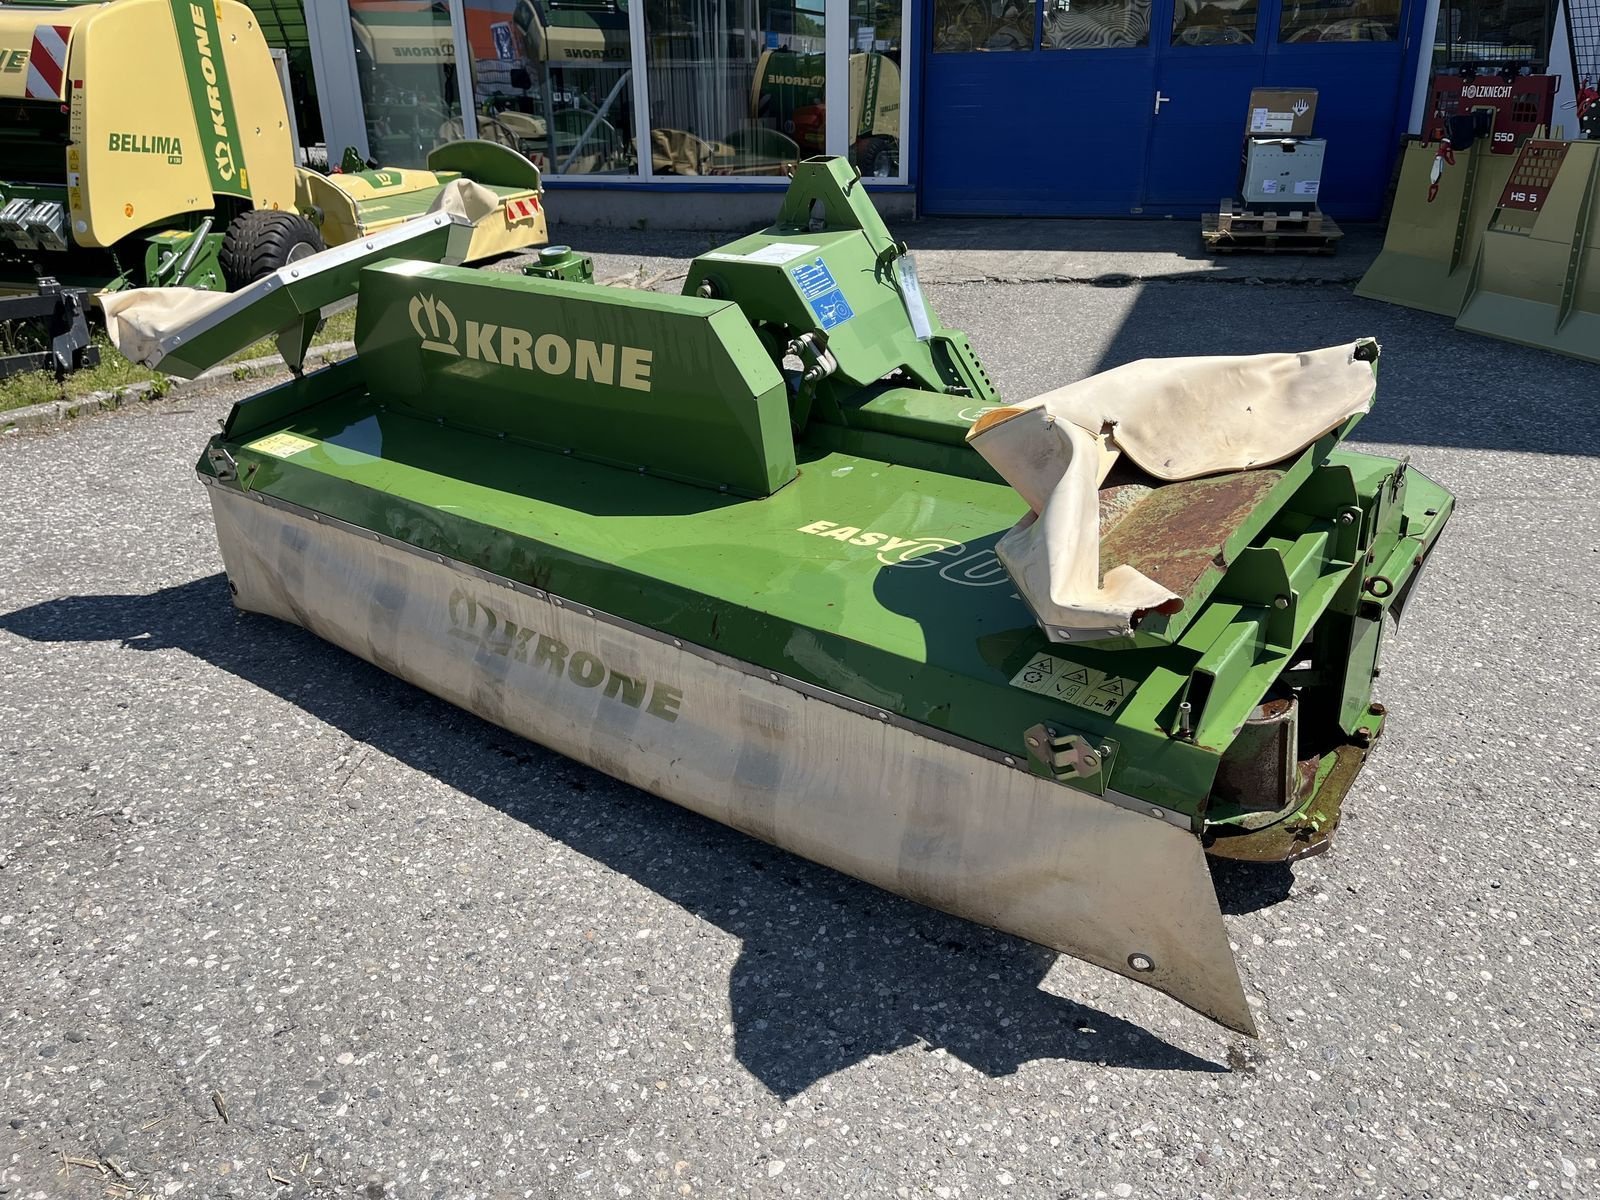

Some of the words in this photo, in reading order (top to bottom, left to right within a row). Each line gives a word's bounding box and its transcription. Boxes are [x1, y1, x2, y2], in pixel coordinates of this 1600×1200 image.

[189, 2, 229, 138] KRONE
[1461, 84, 1513, 99] HOLZKNECHT
[108, 133, 182, 155] BELLIMA
[1494, 132, 1515, 142] 550
[1510, 191, 1526, 202] HS
[1529, 193, 1537, 203] 5
[465, 320, 653, 392] KRONE
[499, 619, 684, 724] KRONE
